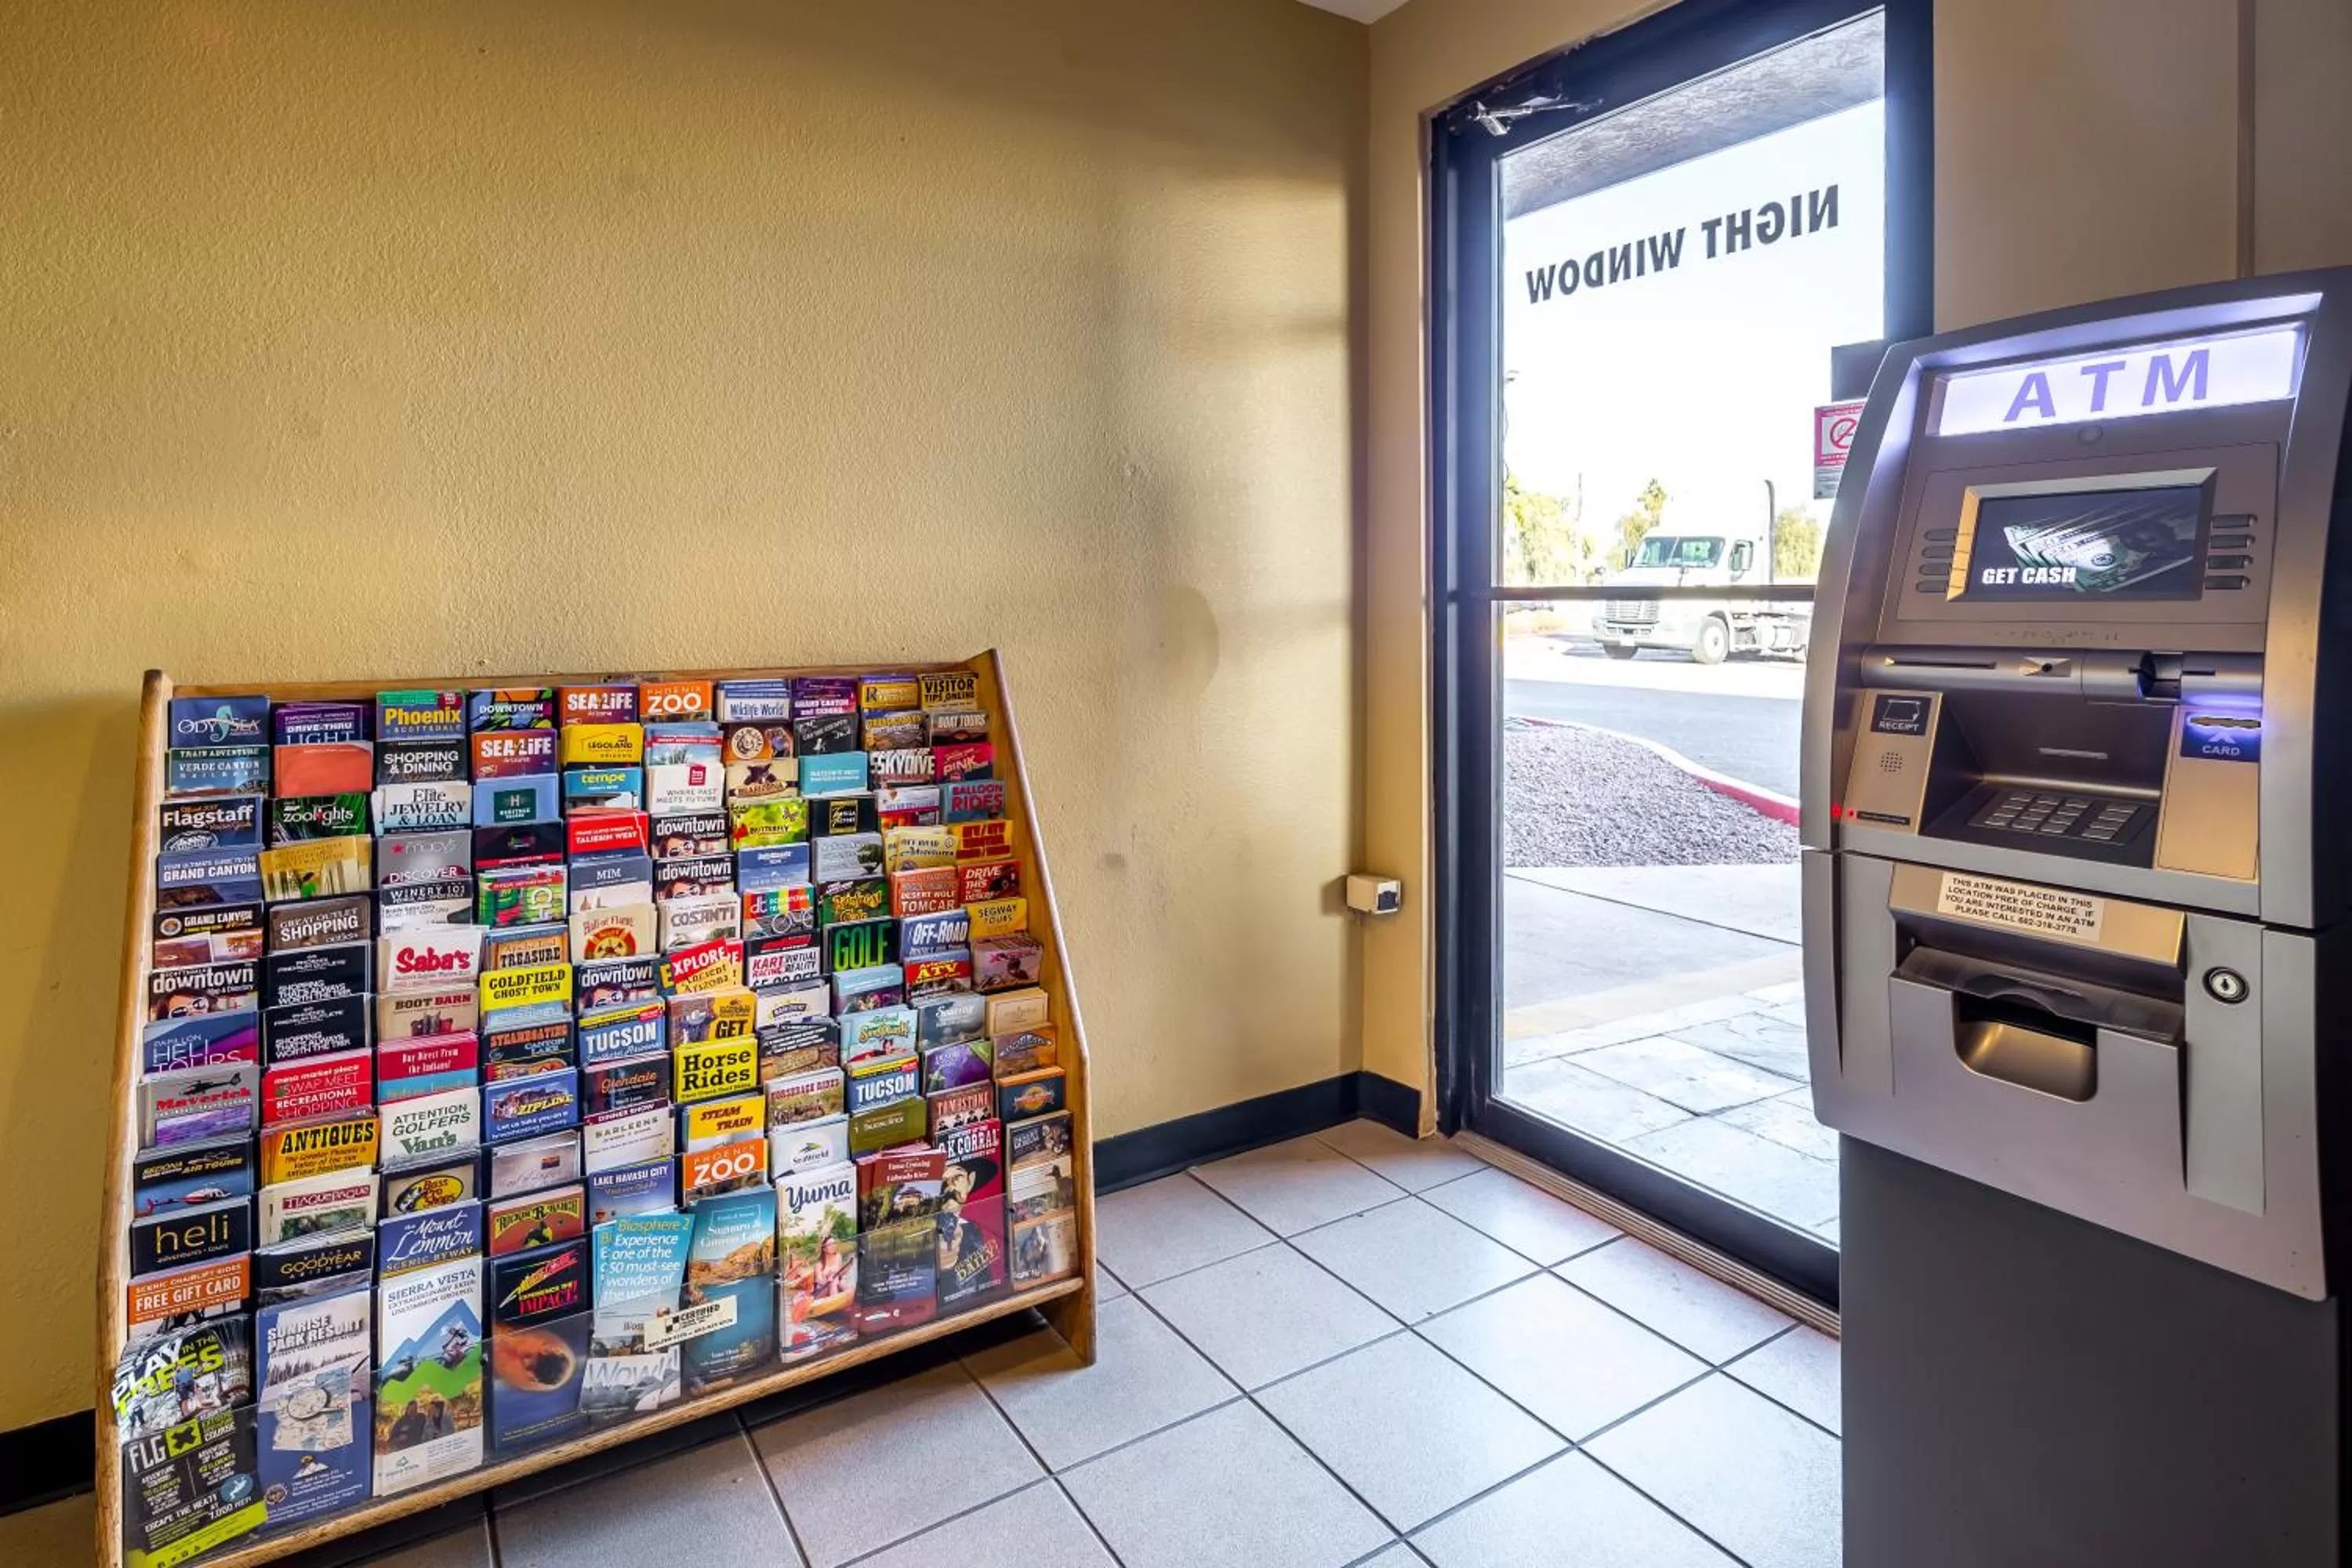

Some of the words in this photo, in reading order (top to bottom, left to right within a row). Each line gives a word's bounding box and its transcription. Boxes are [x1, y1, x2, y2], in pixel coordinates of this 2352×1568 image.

[2003, 350, 2209, 422] ATM
[1982, 568, 2018, 584] GET
[2022, 567, 2076, 583] CASH
[647, 686, 701, 695] PHOENIX
[924, 679, 974, 693] VISITOR
[480, 704, 543, 713] DOWNTOWN
[648, 693, 702, 714] ZOO
[385, 706, 461, 726] Phoenix
[1879, 721, 1919, 731] RECEIPT
[286, 721, 352, 733] DRIVE-THRU
[384, 750, 459, 764] SHOPPING
[2202, 745, 2240, 756] CARD
[179, 762, 215, 771] VERDE
[217, 761, 260, 771] CANYON
[390, 764, 399, 775] &
[404, 760, 452, 773] DINING
[878, 752, 935, 774] SKYDIVE
[581, 771, 626, 784] tempe
[413, 789, 446, 803] Elite
[953, 786, 1002, 796] BALLOON
[390, 801, 466, 815] JEWELRY
[952, 794, 1003, 811] RIDES
[163, 804, 254, 827] Flagstaff
[399, 815, 411, 825] &
[417, 812, 456, 823] LOAN
[656, 815, 725, 836] downtown
[163, 868, 205, 882] GRAND
[209, 862, 256, 877] CANYON
[390, 867, 457, 884] DISCOVER
[597, 868, 622, 880] MIM
[662, 860, 731, 880] downtown
[965, 866, 1002, 880] DRIVE
[390, 887, 444, 899] WINERY
[1948, 887, 1992, 900] LOCATION
[1995, 895, 2018, 904] FREE
[1953, 878, 1972, 887] THIS
[1973, 882, 1992, 891] ATM
[1994, 885, 2015, 895] WAS
[2018, 889, 2056, 902] PLACED
[2071, 898, 2092, 908] THIS
[902, 901, 955, 912] TOMCAR
[978, 905, 1018, 917] SEGWAY
[1946, 894, 1962, 904] YOU
[1986, 902, 2042, 917] INTERESTED
[2057, 914, 2071, 923] AN
[1955, 906, 1990, 916] PLEASE
[1992, 912, 2015, 923] CALL
[184, 914, 215, 927] GRAND
[217, 911, 252, 922] CANYON
[671, 907, 735, 927] COSANTI
[281, 915, 358, 941] SHOPPING
[913, 920, 967, 946] OFF-ROAD
[500, 947, 561, 967] TREASURE
[834, 924, 891, 972] GOLF
[396, 947, 471, 974] Saba's
[753, 956, 784, 968] KART
[916, 962, 958, 979] ATV
[153, 967, 252, 993] downtown
[489, 969, 565, 989] GOLDFIELD
[493, 986, 528, 1000] GHOST
[532, 983, 561, 994] TOWN
[395, 998, 432, 1010] BOOT
[434, 994, 471, 1005] BARN
[587, 1023, 655, 1051] TUCSON
[716, 1020, 748, 1038] GET
[154, 1039, 209, 1065] HELI
[524, 1038, 565, 1050] CANYON
[684, 1049, 751, 1073] Horse
[283, 1080, 321, 1096] SWAP
[326, 1073, 358, 1085] MEET
[684, 1069, 750, 1091] Rides
[856, 1073, 915, 1102] TUCSON
[158, 1087, 251, 1109] Maverick
[277, 1087, 357, 1108] RECREATIONAL
[517, 1094, 574, 1115] ZIPLINE
[277, 1098, 358, 1120] SHOPPING
[394, 1104, 468, 1124] ATTENTION
[699, 1106, 742, 1121] STEAM
[393, 1112, 471, 1136] GOLFERS
[717, 1116, 753, 1131] TRAIN
[281, 1122, 374, 1153] ANTIQUES
[401, 1131, 457, 1154] Van's
[957, 1128, 1000, 1153] CORRAL
[793, 1151, 829, 1163] SeaWorld
[593, 1175, 616, 1186] LAKE
[619, 1170, 648, 1183] HAVASU
[650, 1167, 668, 1178] CITY
[694, 1153, 754, 1186] ZOO
[786, 1180, 853, 1212] Yuma
[156, 1214, 228, 1254] heli
[416, 1211, 467, 1240] Mount
[618, 1221, 680, 1232] Biosphere
[682, 1220, 690, 1229] 2
[387, 1231, 474, 1262] Lemmon
[615, 1235, 678, 1246] Experience
[281, 1250, 361, 1273] GOODYEAR
[434, 1247, 474, 1261] BYWAY
[612, 1249, 635, 1259] one
[637, 1247, 651, 1259] of
[652, 1245, 671, 1258] the
[609, 1264, 624, 1273] 50
[627, 1261, 681, 1272] must-see
[136, 1282, 167, 1293] SCENIC
[218, 1264, 241, 1274] RIDES
[388, 1278, 434, 1302] SIERRA
[438, 1269, 476, 1285] VISTA
[607, 1275, 659, 1286] wonders
[661, 1273, 674, 1284] of
[136, 1292, 168, 1311] FREE
[172, 1284, 202, 1304] GIFT
[206, 1277, 241, 1295] CARD
[519, 1281, 578, 1315] IMPACT!
[681, 1304, 720, 1320] CERTIFIED
[182, 1342, 194, 1353] IN
[269, 1332, 308, 1353] PARK
[129, 1436, 166, 1474] FLG
